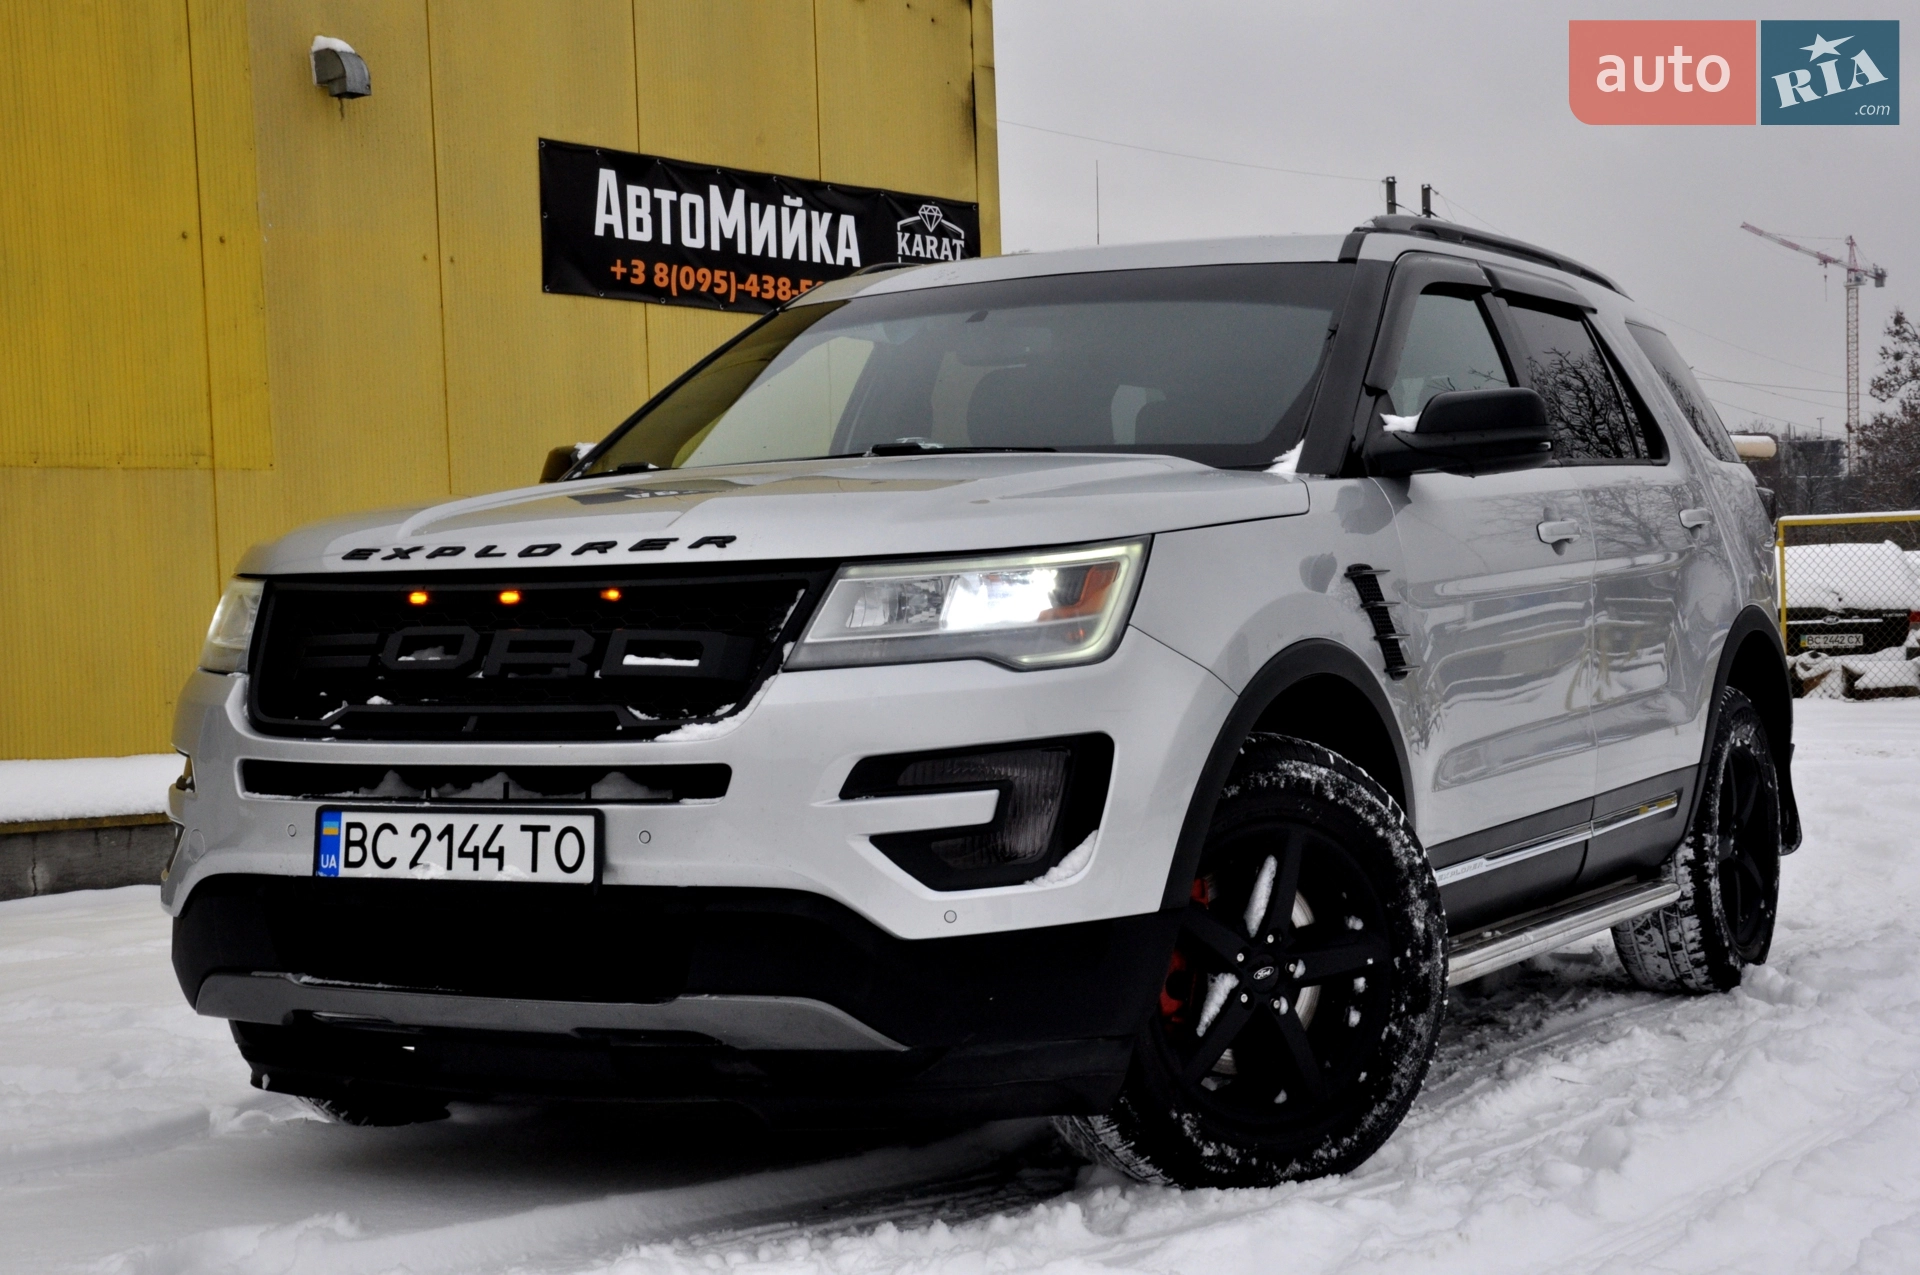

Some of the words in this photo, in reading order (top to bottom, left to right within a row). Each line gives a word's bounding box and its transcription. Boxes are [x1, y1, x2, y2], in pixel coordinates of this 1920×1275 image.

[896, 231, 965, 261] KARAT
[653, 262, 826, 303] 8(095)-438-
[341, 535, 738, 560] EXPLORER
[297, 625, 742, 680] FORD
[1823, 635, 1846, 645] 2442
[320, 853, 338, 869] UA
[343, 821, 399, 870] BC
[408, 822, 506, 872] 2144
[519, 824, 586, 874] TO
